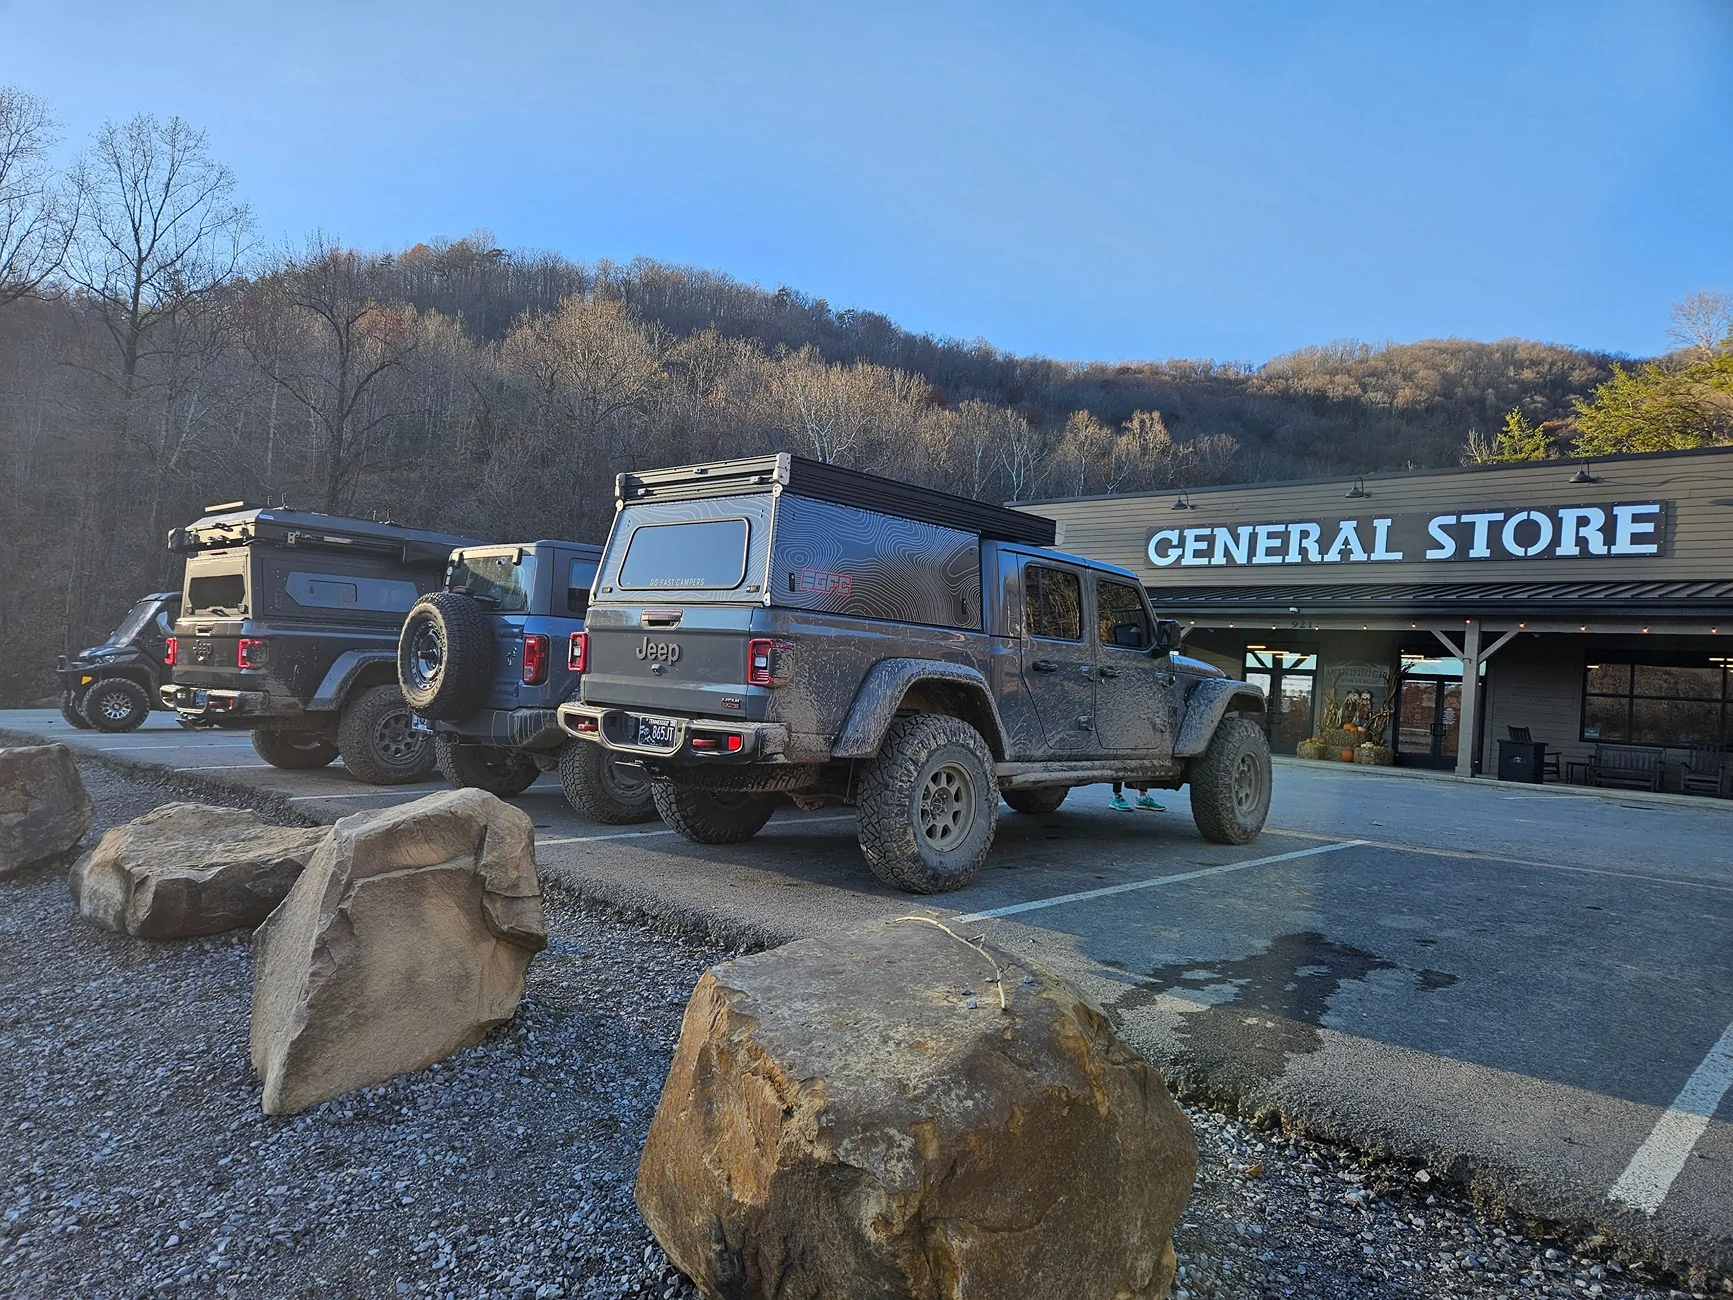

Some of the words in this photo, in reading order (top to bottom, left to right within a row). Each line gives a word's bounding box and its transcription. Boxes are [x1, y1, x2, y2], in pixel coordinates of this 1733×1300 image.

[1148, 518, 1403, 567] GENERAL
[1425, 504, 1660, 560] STORE
[676, 578, 705, 586] CAMPERS
[1291, 620, 1313, 629] 921
[635, 636, 680, 666] Jeep
